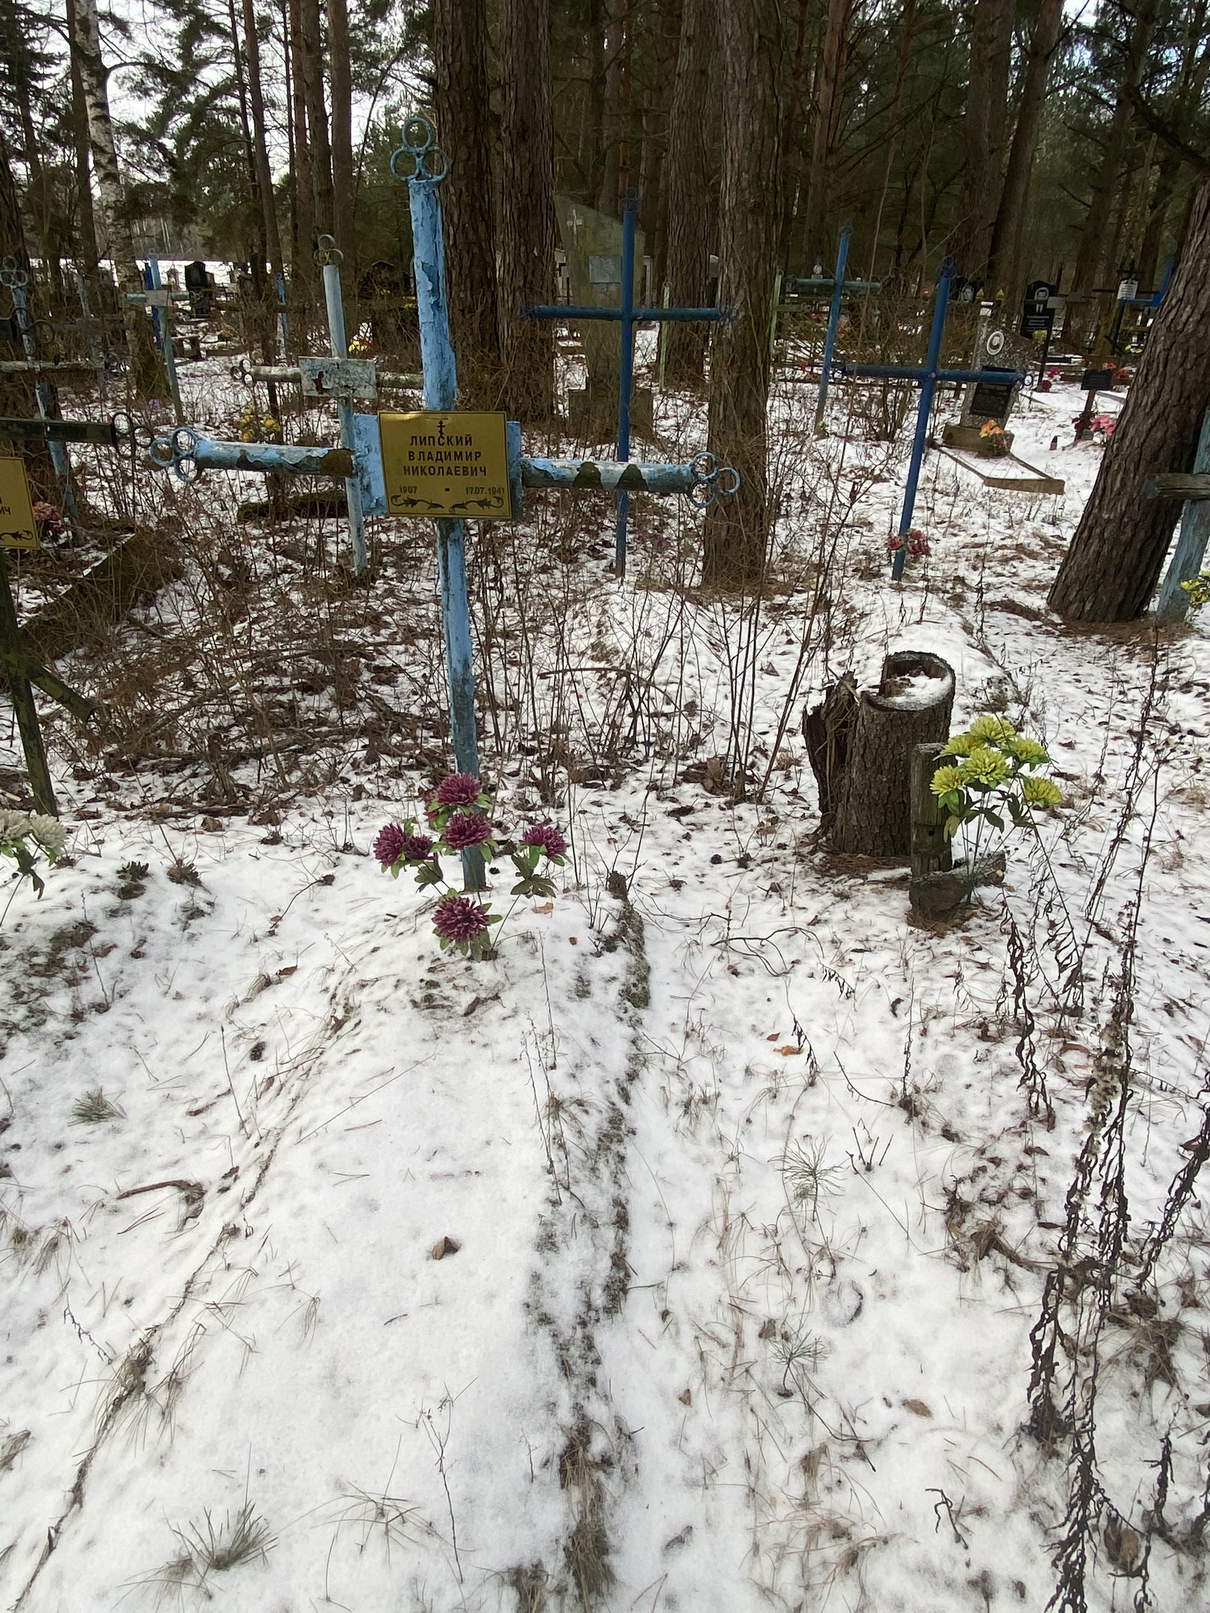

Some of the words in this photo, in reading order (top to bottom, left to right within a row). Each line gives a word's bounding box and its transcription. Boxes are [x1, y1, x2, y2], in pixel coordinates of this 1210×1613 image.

[410, 434, 472, 446] ЛИПСКИЙ
[409, 451, 481, 463] ВЛАДИМИР
[404, 466, 486, 476] НИКОЛАЕВИЧ
